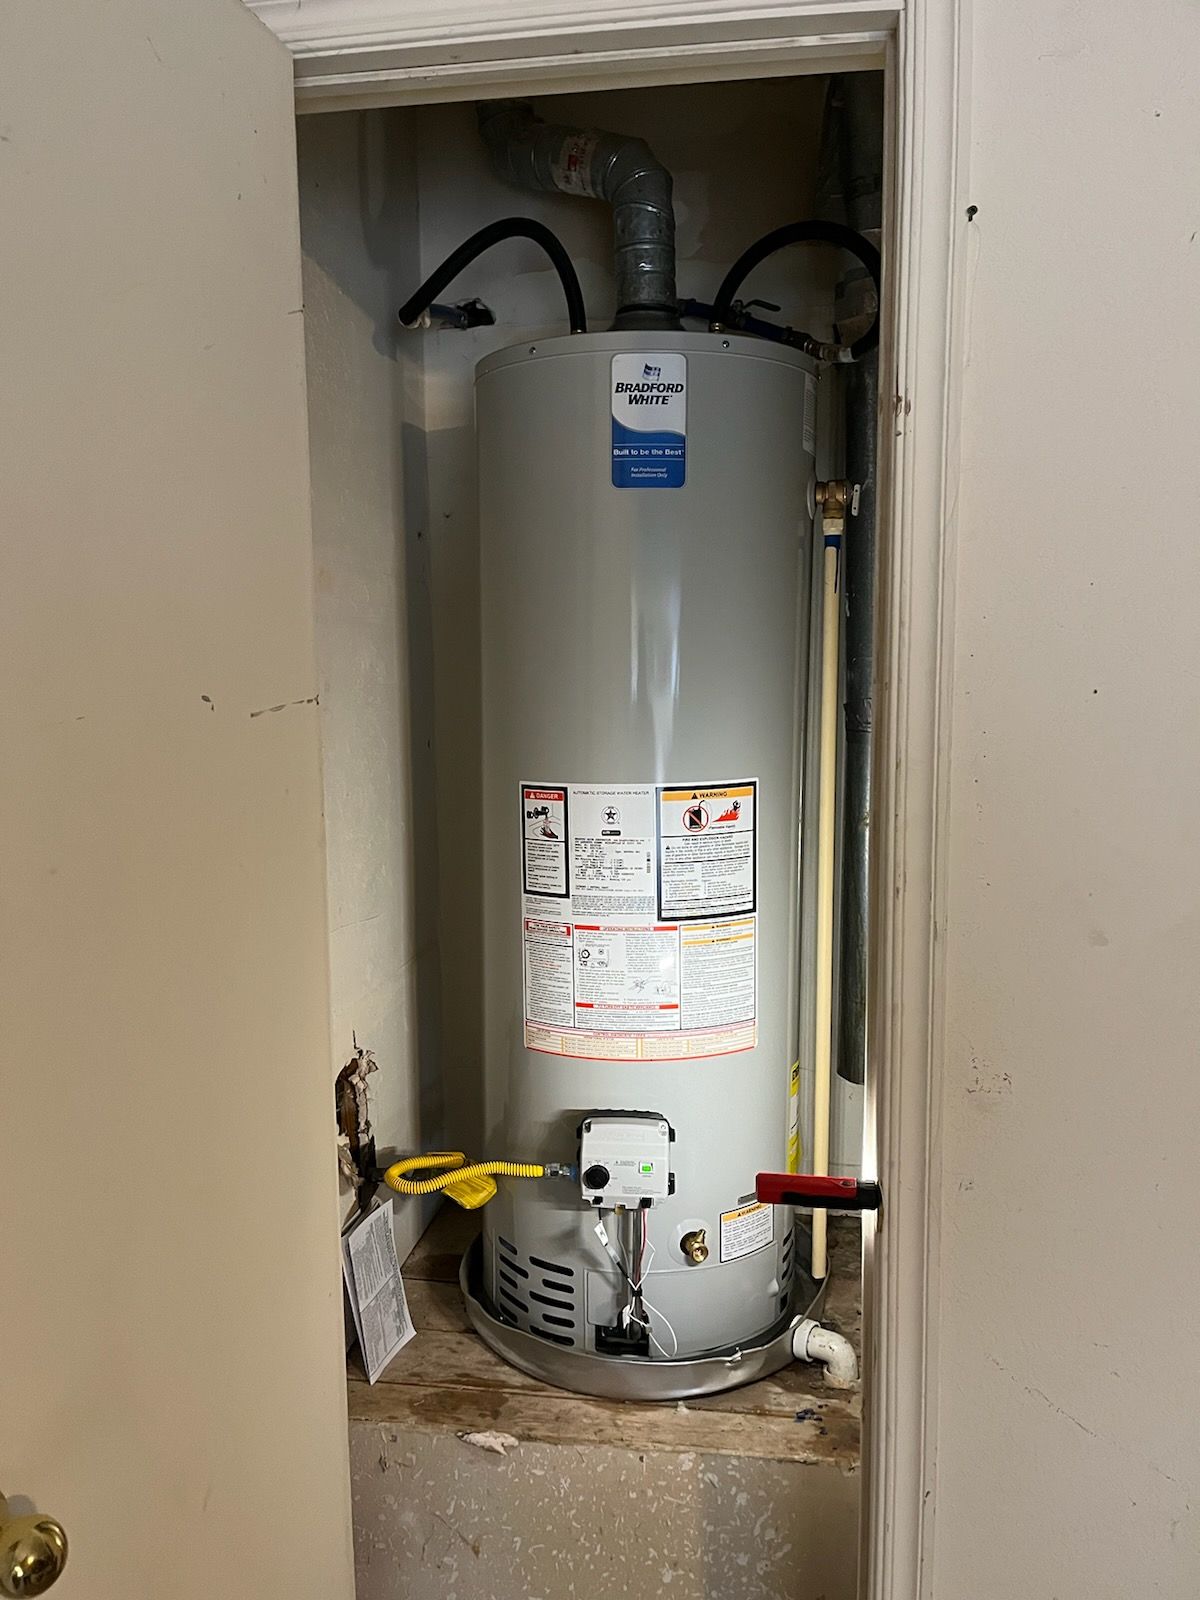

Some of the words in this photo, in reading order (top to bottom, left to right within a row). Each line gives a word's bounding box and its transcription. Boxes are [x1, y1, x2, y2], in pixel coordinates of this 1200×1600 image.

[615, 382, 684, 394] BRADFORD
[628, 394, 669, 405] WHITE
[613, 448, 629, 456] Built
[630, 448, 639, 456] to
[640, 448, 650, 456] be
[651, 448, 663, 456] the
[664, 448, 682, 456] Best
